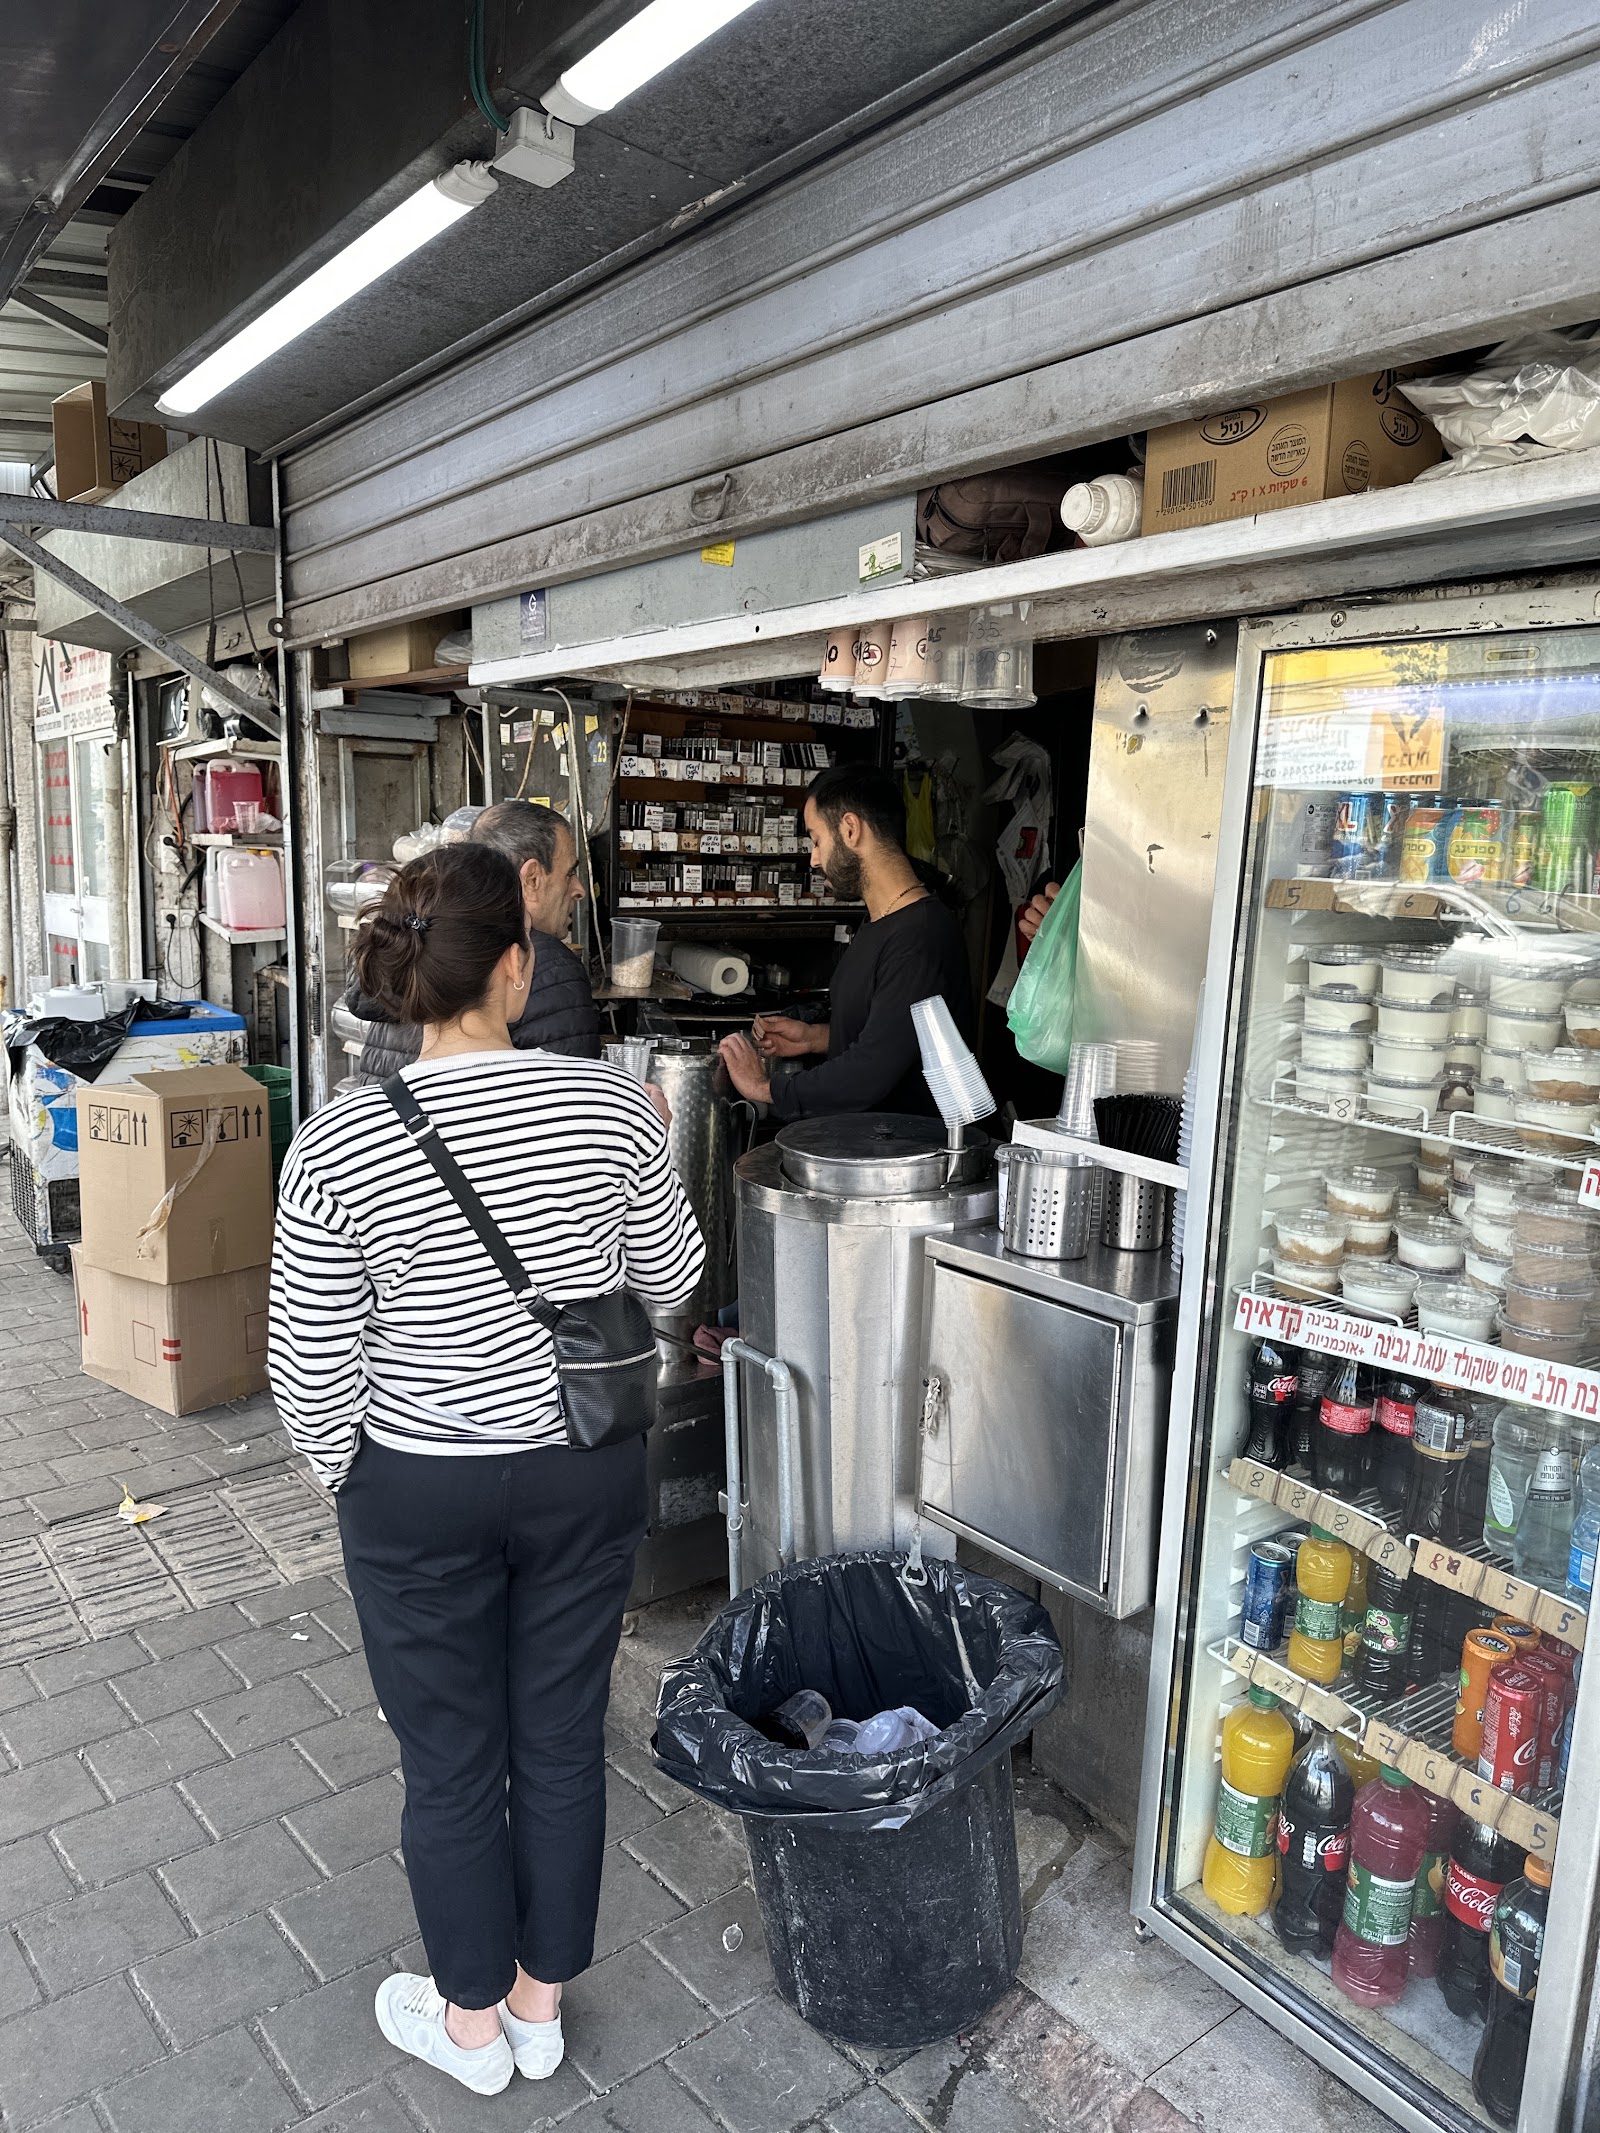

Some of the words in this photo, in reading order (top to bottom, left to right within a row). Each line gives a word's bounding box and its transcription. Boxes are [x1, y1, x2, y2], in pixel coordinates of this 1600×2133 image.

[1220, 420, 1244, 438] וניל
[1267, 478, 1299, 494] שקיות
[1301, 475, 1308, 487] 6
[1155, 510, 1160, 518] 7
[1162, 505, 1187, 516] 290104
[1188, 499, 1213, 511] 501296
[824, 639, 839, 672] 10
[1454, 844, 1496, 855] ספרינג
[1283, 887, 1302, 907] 5
[1404, 894, 1414, 908] 6
[1334, 1098, 1351, 1118] 8
[1239, 1296, 1304, 1341] קדאיף
[1306, 1312, 1339, 1331] גבינה
[1342, 1321, 1374, 1339] עוגת
[1373, 1332, 1411, 1365] גבינה
[1411, 1342, 1449, 1373] עוגת
[1453, 1346, 1500, 1387] שוקולד
[1500, 1363, 1528, 1394] מוס
[1531, 1365, 1568, 1407] חלב
[1250, 1471, 1265, 1488] 8
[1291, 1491, 1306, 1509] 8
[1334, 1513, 1349, 1532] 8
[1380, 1541, 1395, 1559] 8
[1501, 1582, 1518, 1601] 5
[1556, 1611, 1577, 1633] 5
[1378, 1732, 1398, 1755] 7
[1424, 1760, 1436, 1780] 6
[1529, 1822, 1548, 1850] 5
[1453, 1864, 1478, 1884] CLASSIC
[1447, 1874, 1496, 1916] ca-Cola
